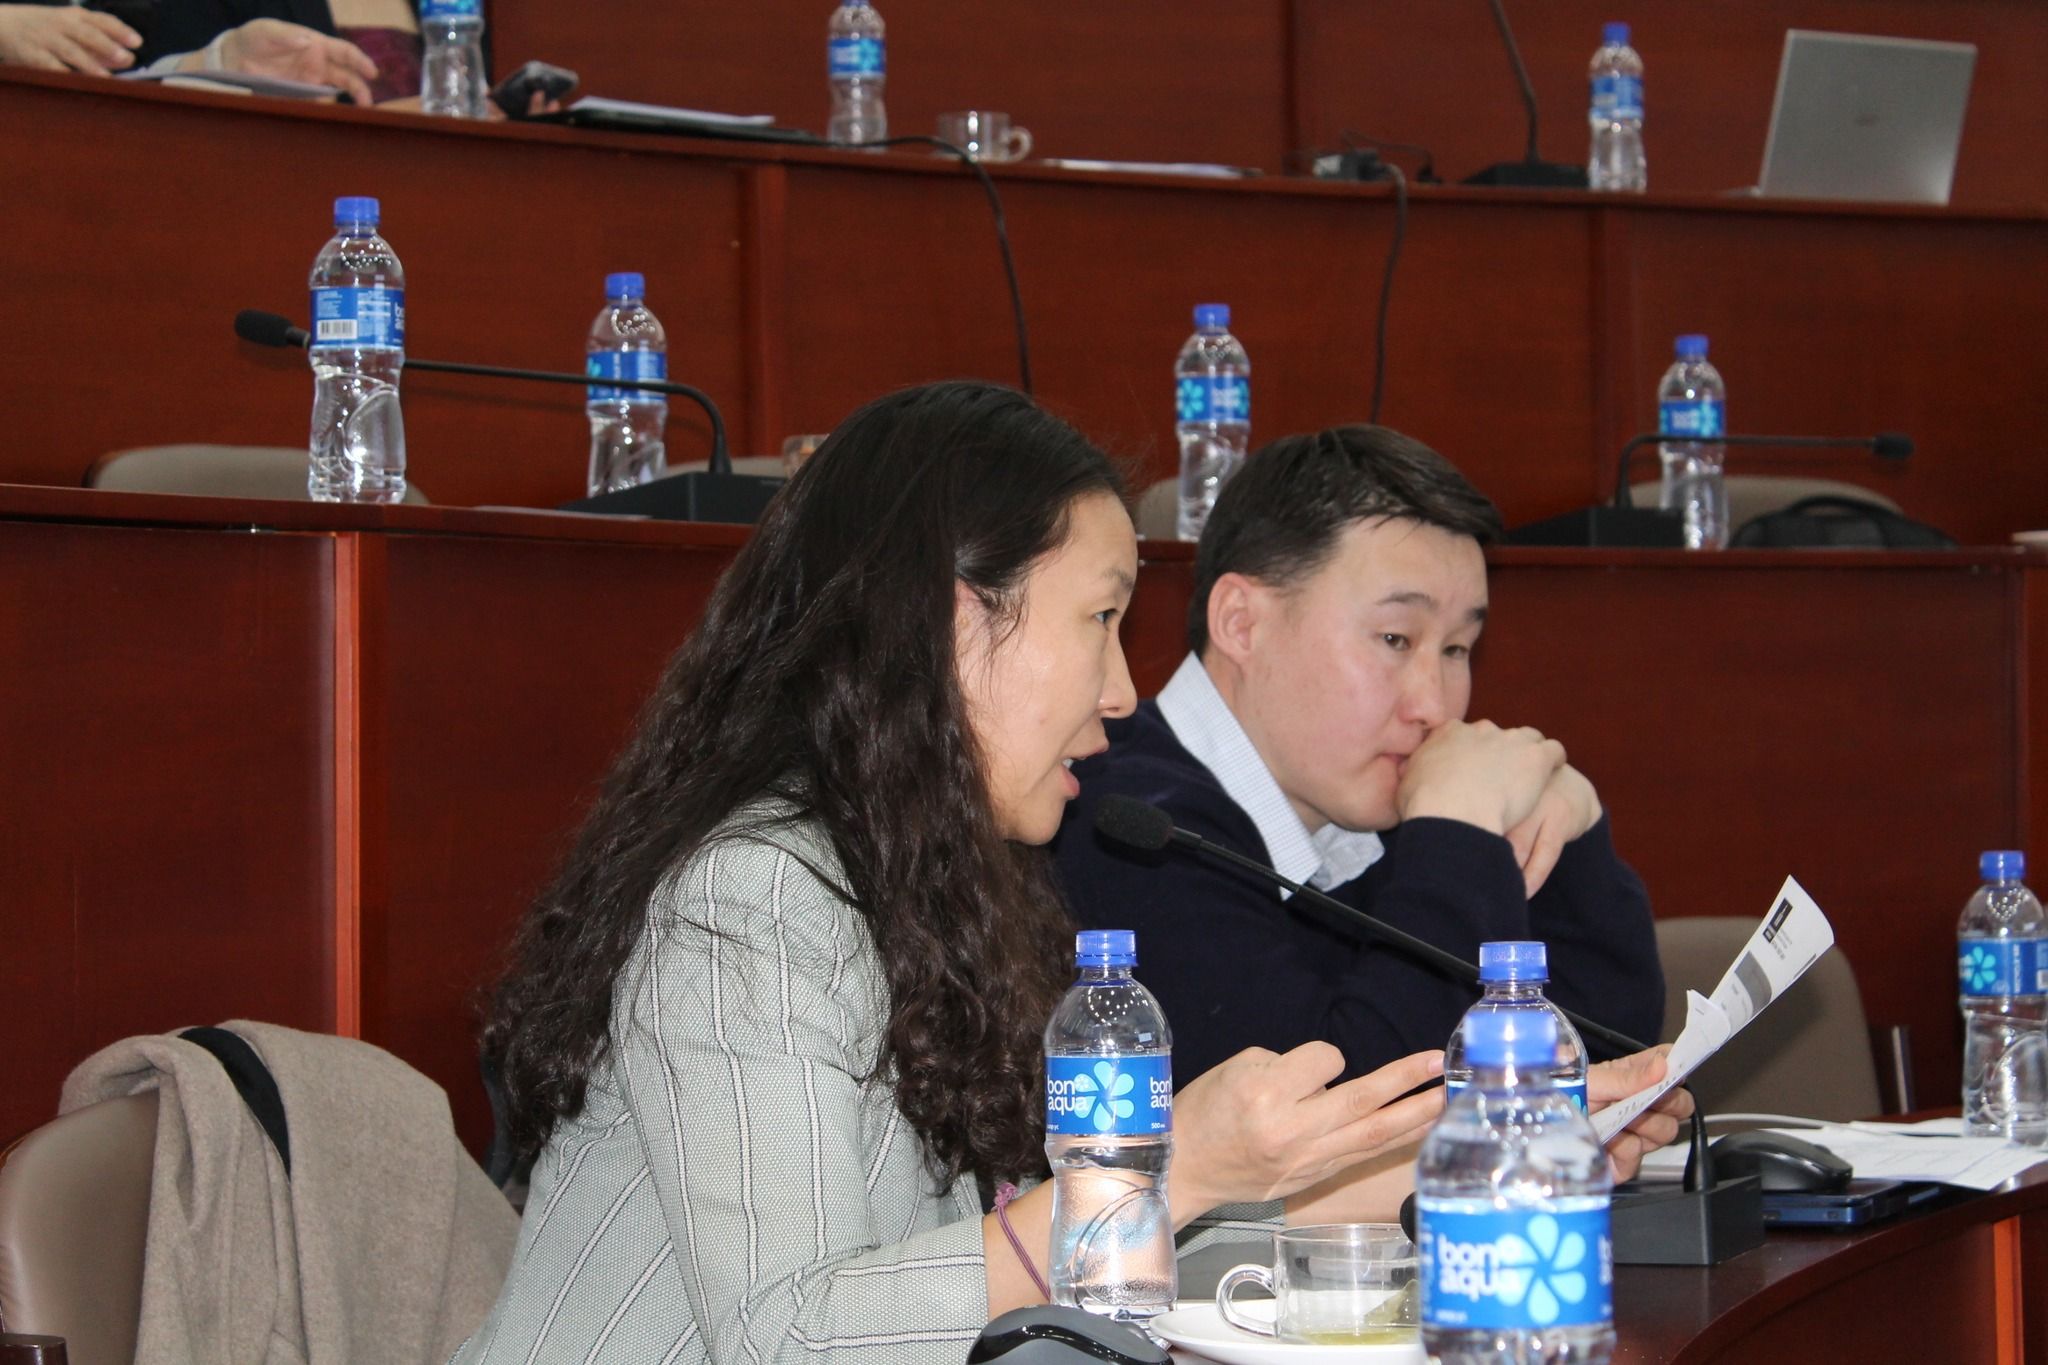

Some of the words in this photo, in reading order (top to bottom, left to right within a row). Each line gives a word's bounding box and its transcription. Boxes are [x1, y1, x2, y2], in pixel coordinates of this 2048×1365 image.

[1047, 1074, 1075, 1095] bon
[1048, 1096, 1087, 1116] aqua
[1151, 1095, 1172, 1111] aqu
[1437, 1232, 1500, 1267] bon
